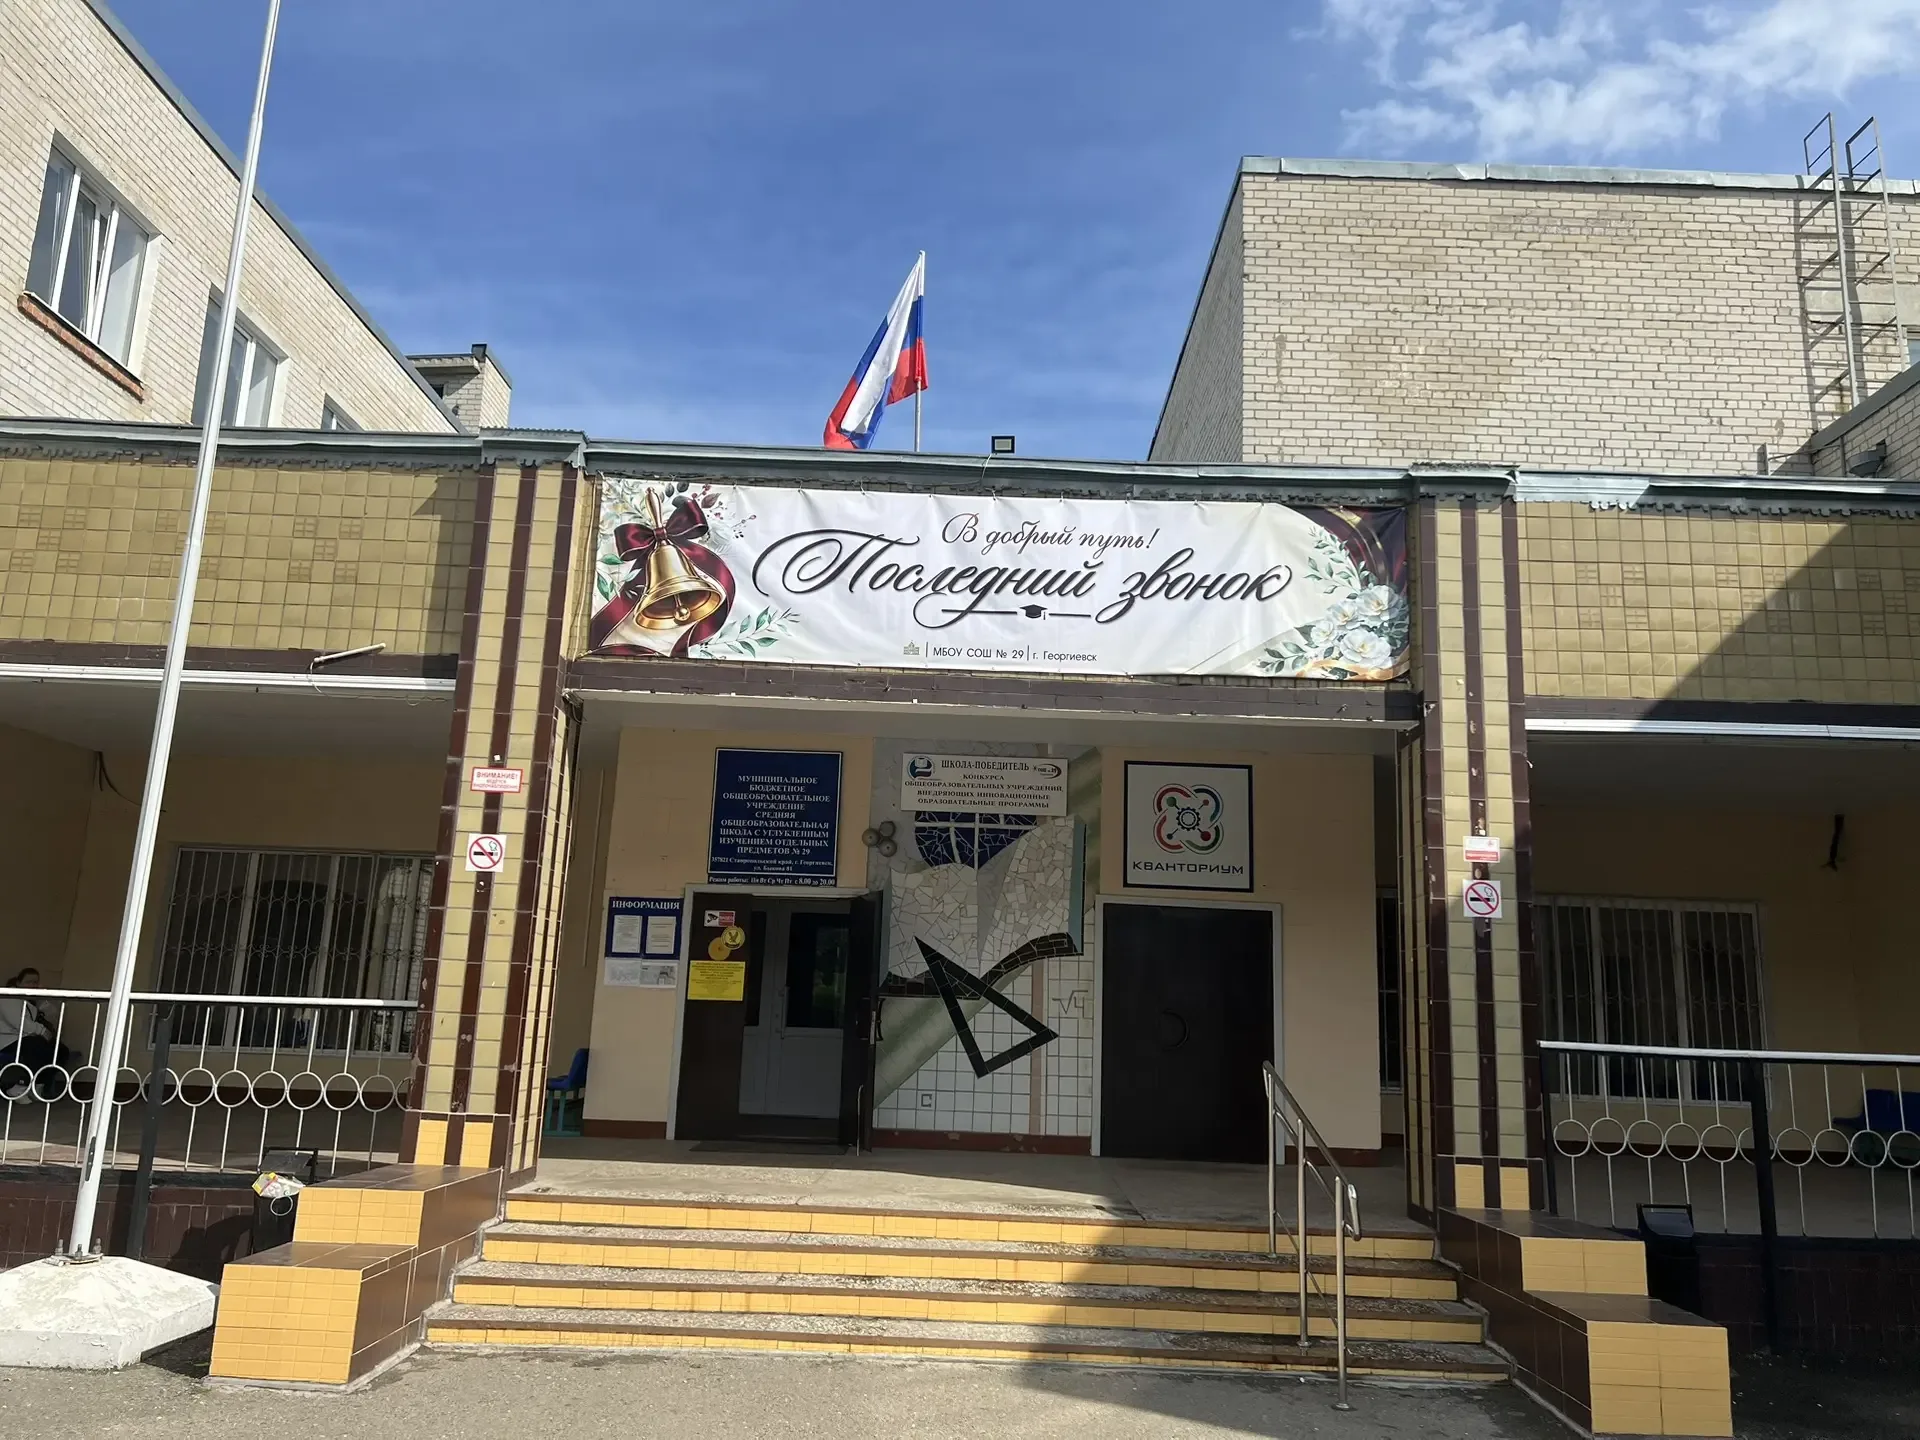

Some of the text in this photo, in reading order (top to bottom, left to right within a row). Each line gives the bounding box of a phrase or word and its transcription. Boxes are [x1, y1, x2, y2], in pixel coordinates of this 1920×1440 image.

[941, 512, 1160, 560] В добрый путь!
[751, 528, 1292, 630] Последний звонок
[933, 647, 1097, 662] МБОУ СОШ № 29 г. Георгиевск
[941, 759, 1029, 771] ШКОЛА-ПОБЕДИТЕЛЬ
[476, 771, 518, 780] ВНИМАНИЕ!
[738, 775, 818, 784] МУНИЦИПАЛЬНОЕ
[963, 773, 1005, 781] КОНКУРСА
[749, 784, 806, 793] БЮДЖЕТНОЕ
[904, 781, 1004, 790] ОБЩЕОБРАЗОВАТЕЛЬНЫХ
[722, 793, 831, 802] ОБЩЕОБРАЗОВАТЕЛЬНОЕ
[917, 790, 1050, 800] ВНЕДРЯЮЩИХ ИННОВАЦИОННЫЕ
[746, 802, 806, 811] УЧРЕЖДЕНИЕ
[917, 798, 1049, 809] ОБРАЗОВАТЕЛЬНЫЕ ПРОГРАММЫ
[755, 811, 796, 819] СРЕДНЯЯ
[721, 819, 829, 829] ОБЩЕОБРАЗОВАТЕЛЬНАЯ
[719, 828, 753, 836] ШКОЛА
[762, 829, 829, 838] УГЛУБЛЕННЫМ
[719, 837, 829, 847] ИЗУЧЕНИЕМ ОТДЕЛЬНЫХ
[737, 846, 790, 855] ПРЕДМЕТОВ
[791, 847, 800, 855] №
[1133, 861, 1244, 875] КВАНТОРИУМ
[612, 900, 680, 910] ИНФОРМАЦИЯ
